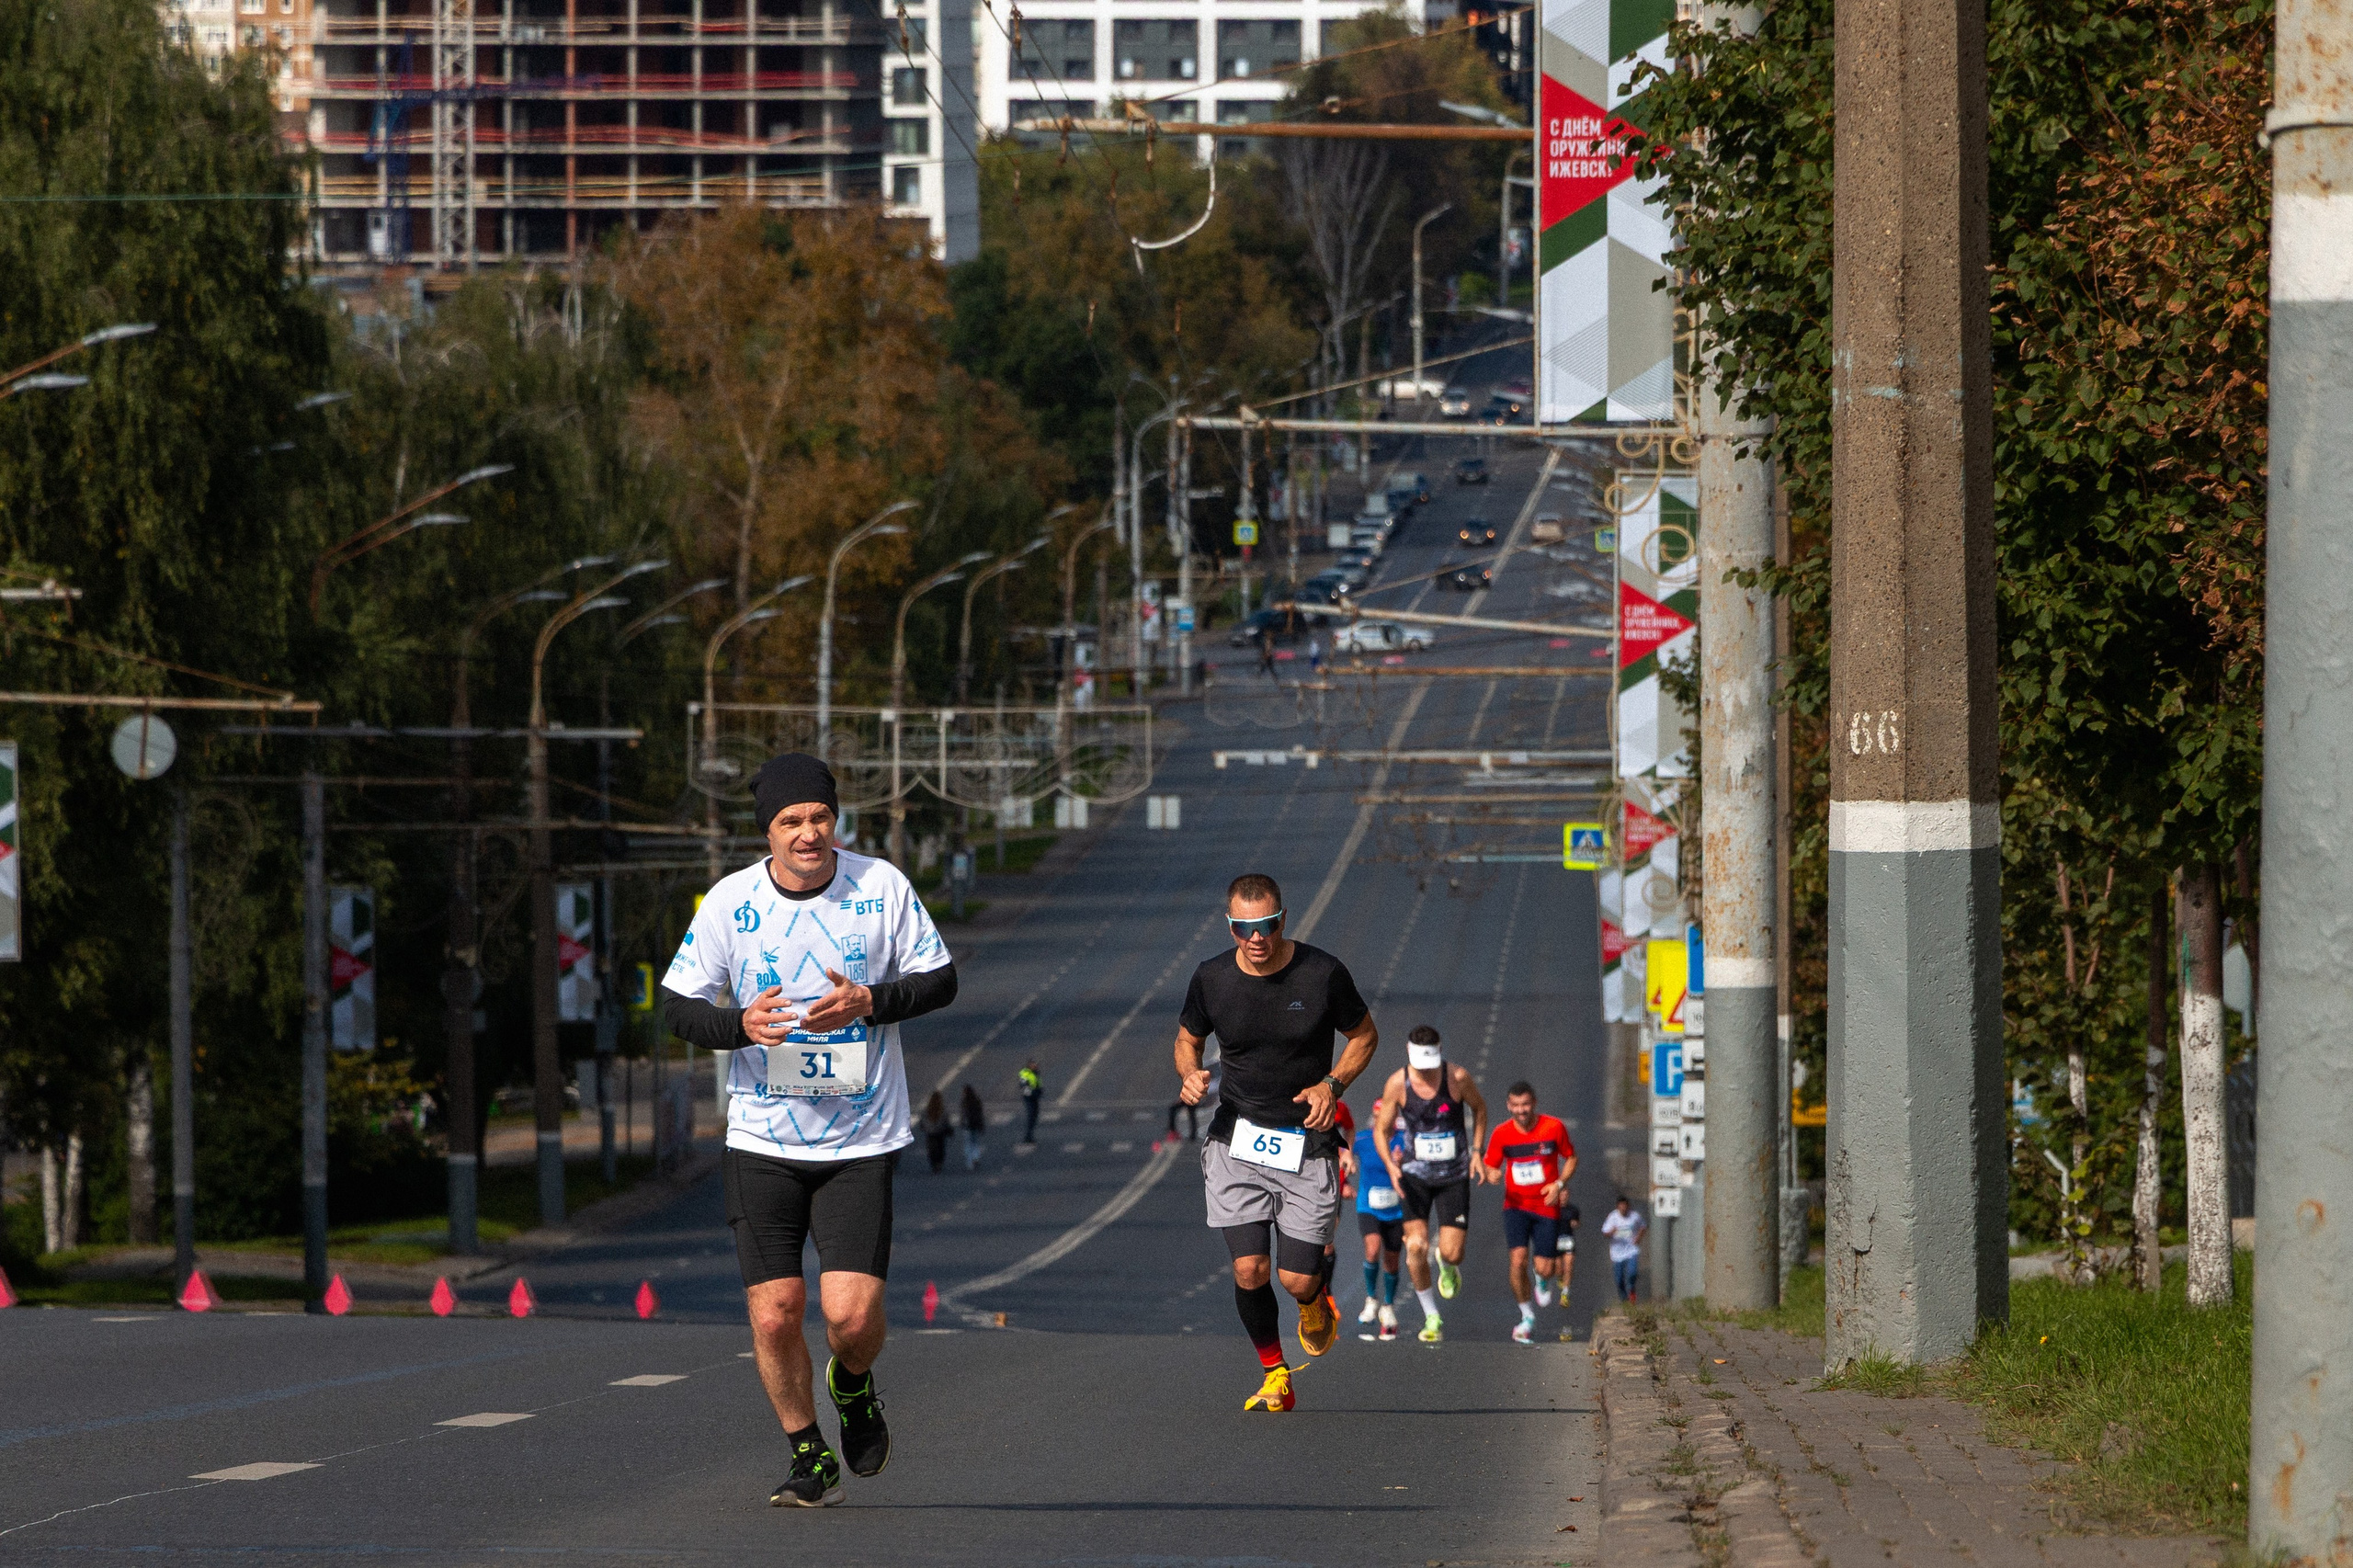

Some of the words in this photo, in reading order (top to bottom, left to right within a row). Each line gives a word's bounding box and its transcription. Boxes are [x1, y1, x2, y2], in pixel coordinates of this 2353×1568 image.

[1550, 119, 1560, 137] С
[1562, 115, 1602, 138] ДНЁМ
[1850, 710, 1899, 755] 66
[855, 898, 884, 915] ВТБ
[756, 972, 769, 985] 80
[848, 964, 865, 983] 185
[800, 1052, 835, 1078] 31
[1253, 1134, 1282, 1155] 65
[1427, 1142, 1442, 1153] 25
